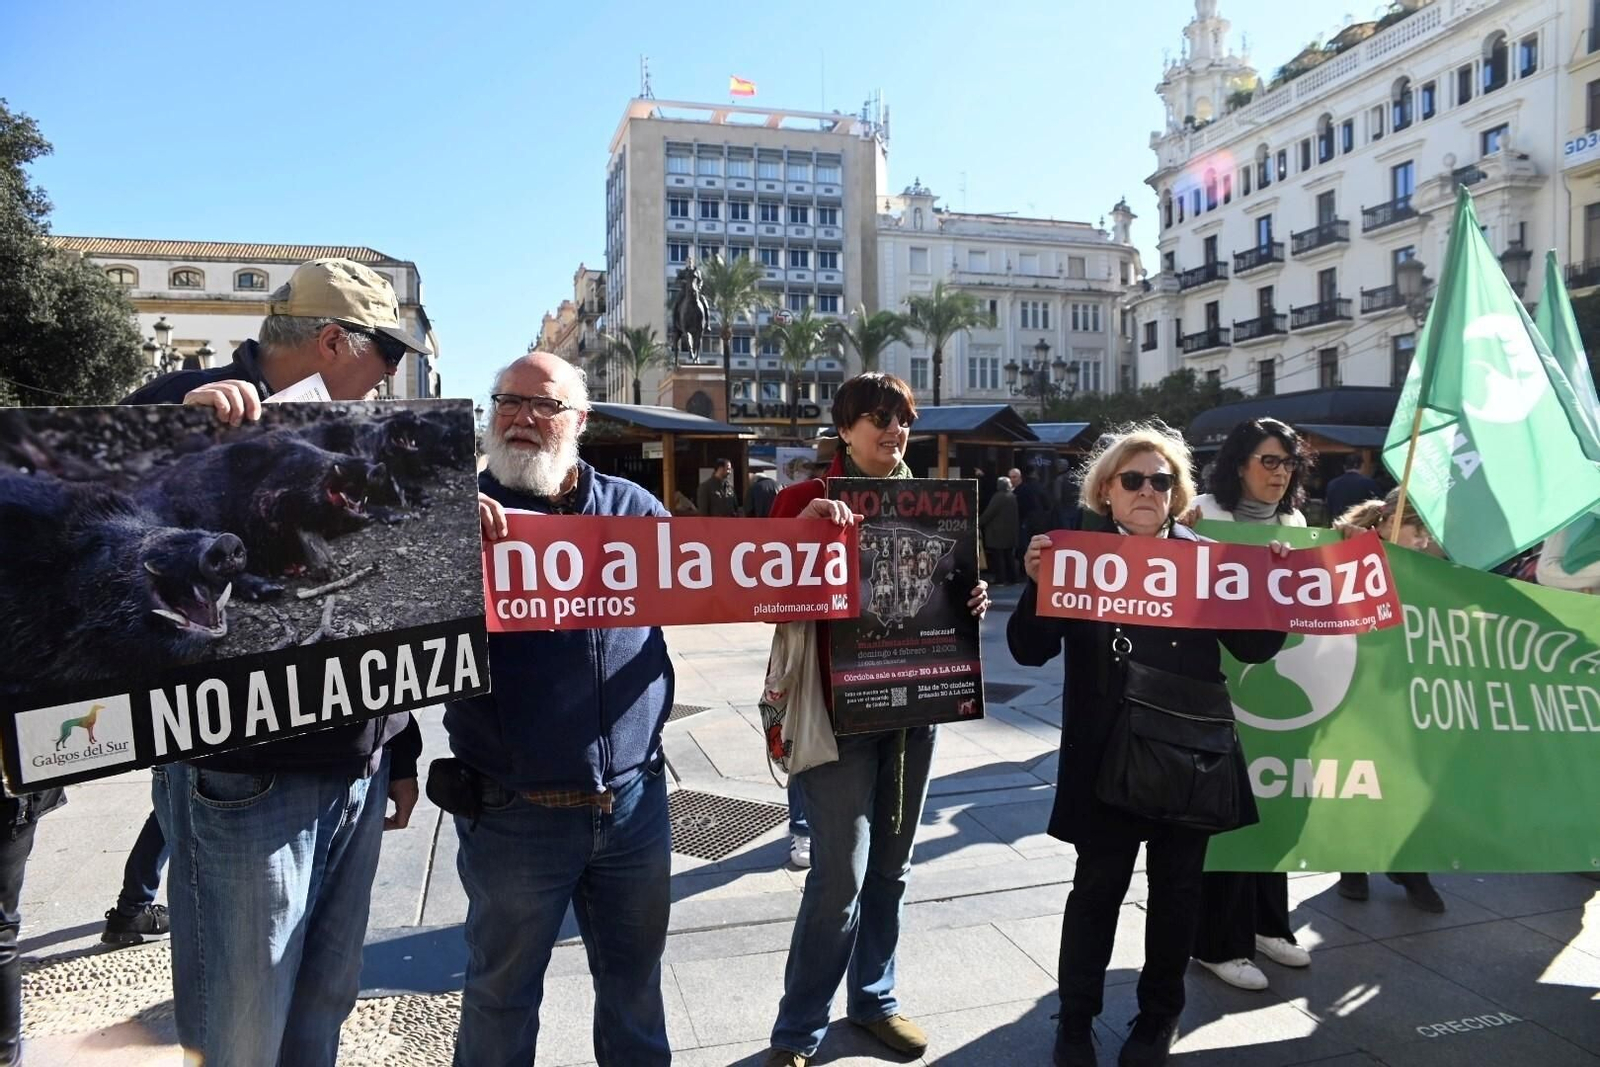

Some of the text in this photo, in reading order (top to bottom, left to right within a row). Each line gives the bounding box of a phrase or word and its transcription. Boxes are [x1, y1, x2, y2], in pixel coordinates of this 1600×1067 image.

[897, 490, 969, 516] CAZA
[938, 519, 968, 532] 2024
[493, 522, 848, 592] no a la caza
[1053, 545, 1387, 607] no a la caza
[497, 596, 636, 624] con perros
[753, 602, 829, 616] plataformanac.org
[1051, 591, 1173, 618] con perros
[1289, 615, 1377, 629] plataformanac.org
[899, 647, 926, 656] febrero
[1401, 604, 1577, 673] PARTIDO
[875, 671, 890, 680] sale
[919, 668, 931, 676] NO
[932, 667, 938, 675] A
[939, 666, 951, 674] LA
[951, 664, 971, 673] CAZA
[149, 632, 481, 756] NO A LA CAZA
[1410, 677, 1480, 730] CON
[1486, 681, 1530, 731] EL
[32, 751, 80, 768] Galgos
[83, 743, 103, 758] del
[106, 741, 129, 753] Sur
[1248, 756, 1383, 800] CMA
[1416, 1012, 1523, 1038] CRECIDA
